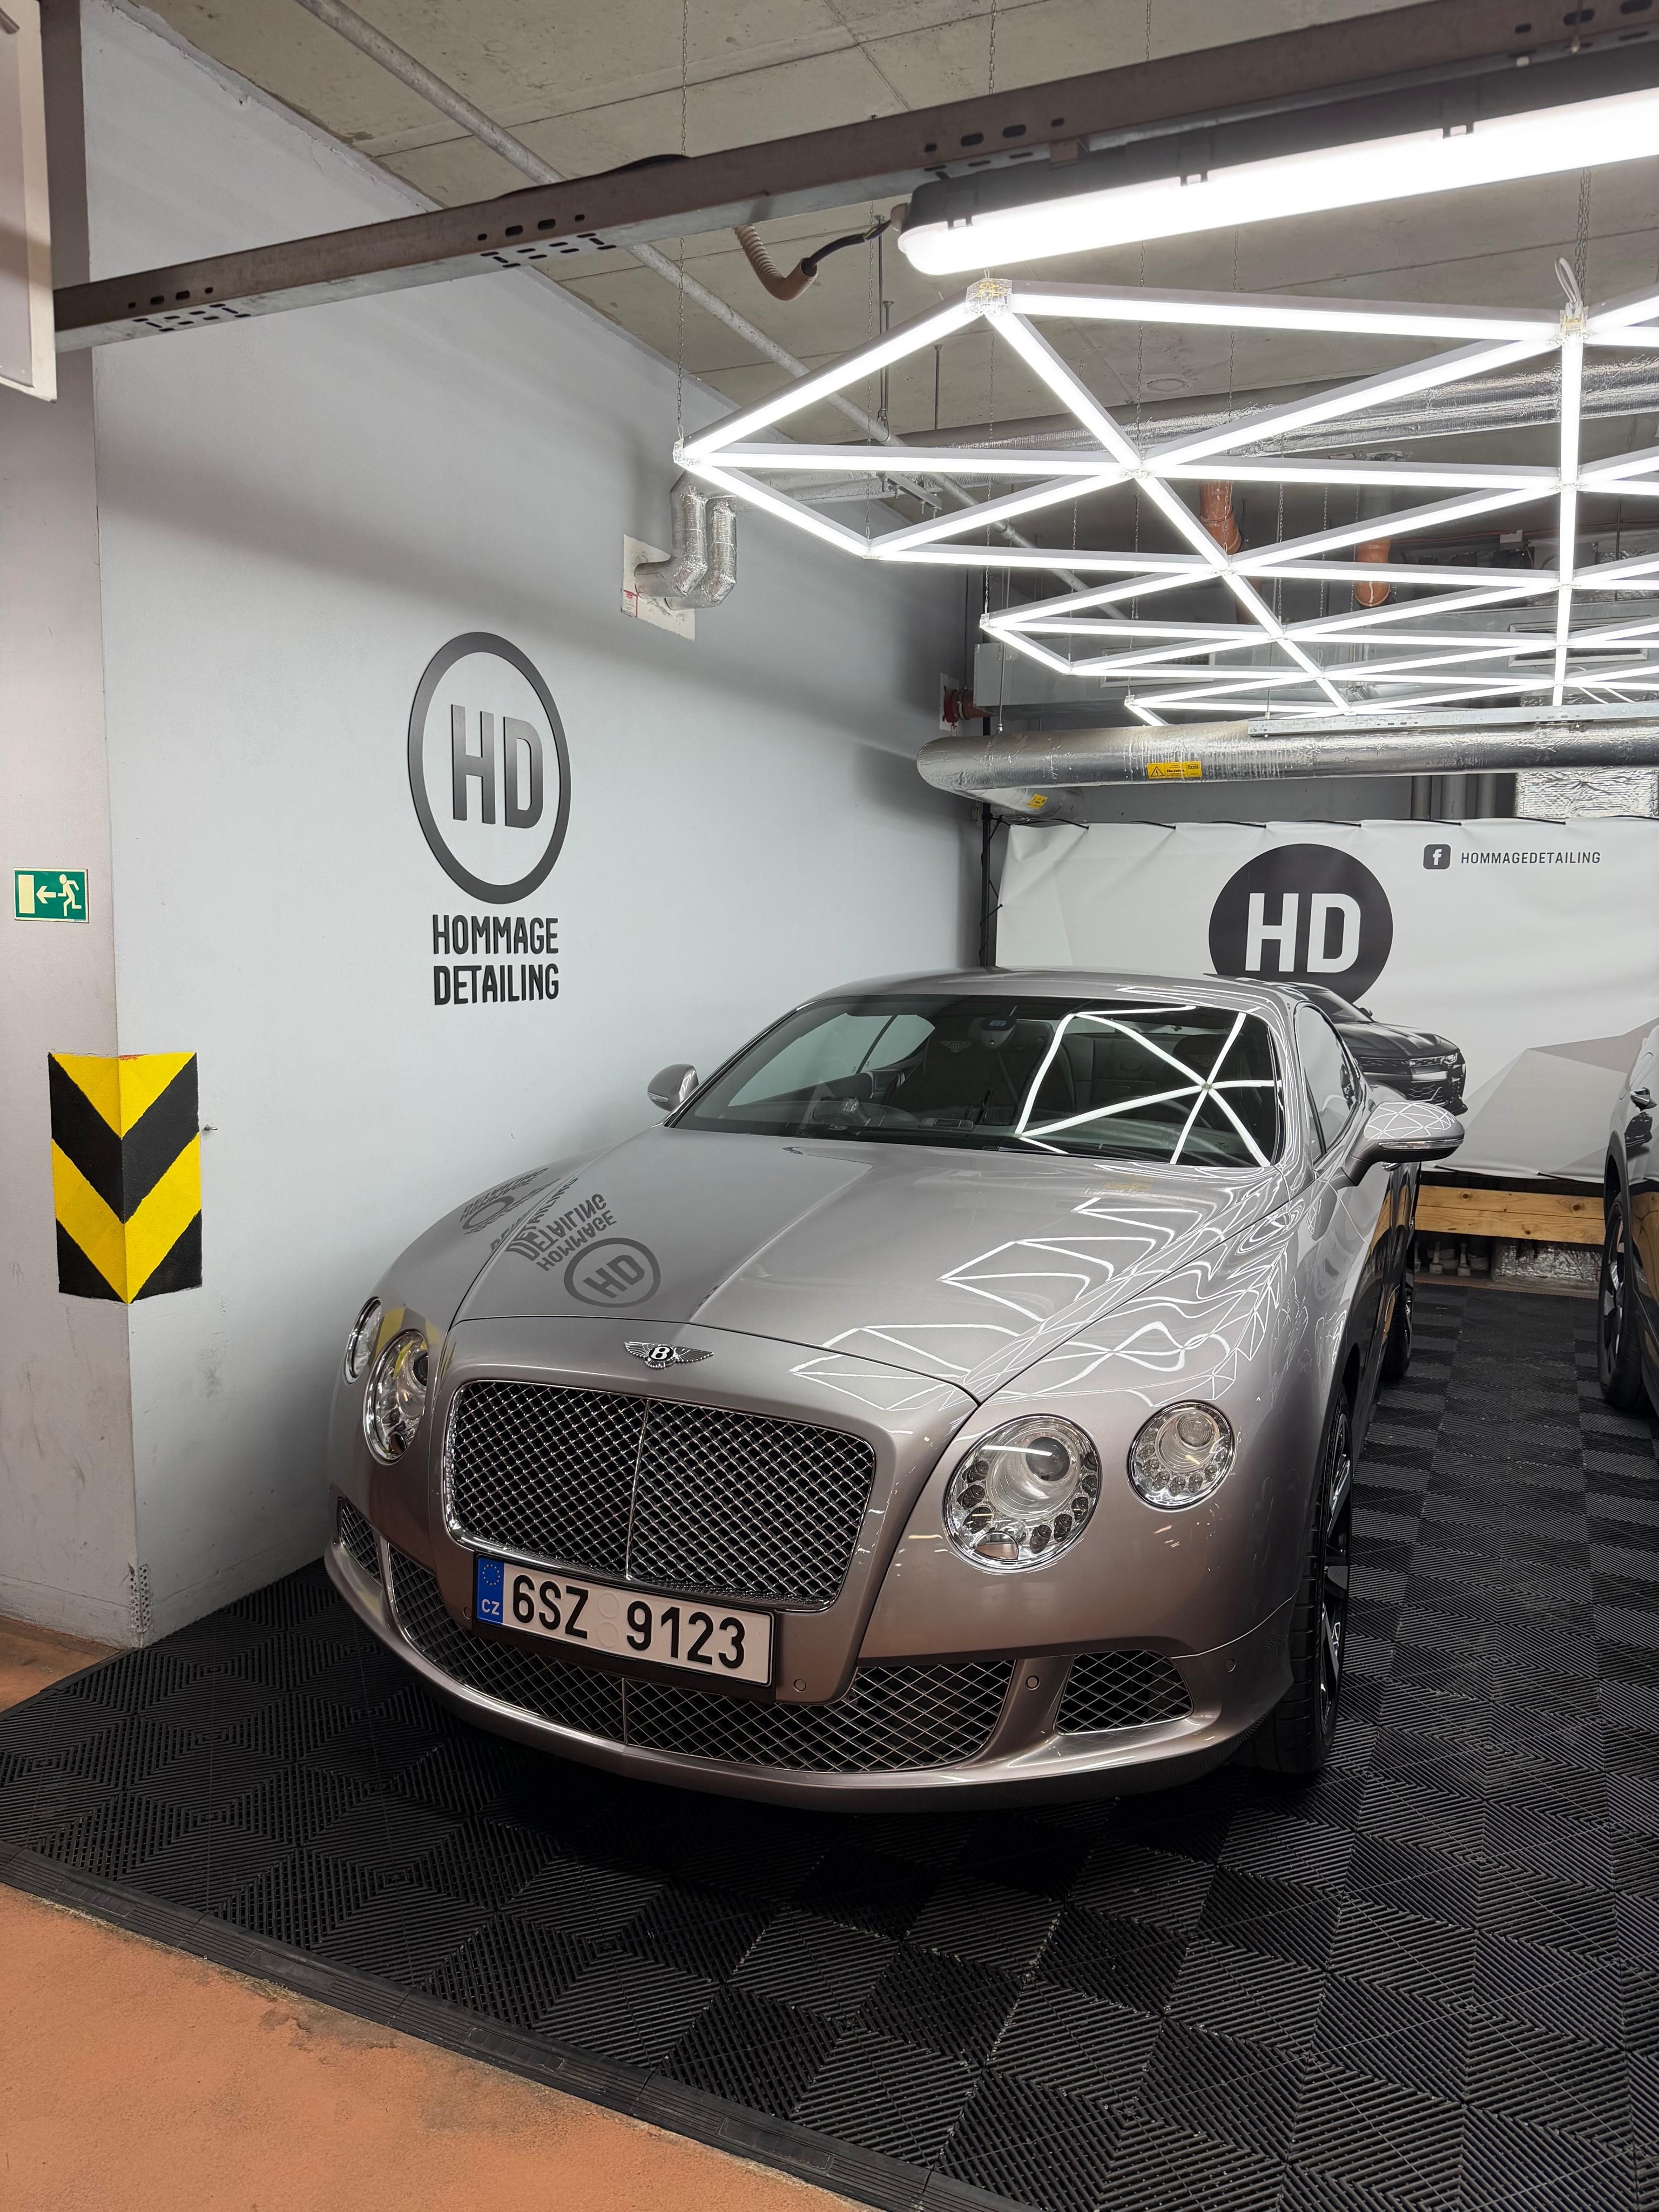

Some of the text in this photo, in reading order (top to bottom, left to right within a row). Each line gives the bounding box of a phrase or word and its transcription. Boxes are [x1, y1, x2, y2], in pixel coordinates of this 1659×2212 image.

[451, 704, 543, 828] HD
[1461, 852, 1601, 864] HOMMAGEDETAILING
[433, 914, 559, 955] HOMMAGE
[1245, 893, 1361, 973] HD
[434, 963, 559, 1005] DETAILING
[651, 1346, 670, 1360] B
[482, 1599, 500, 1615] CZ
[512, 1574, 745, 1668] 6SZ 9123
